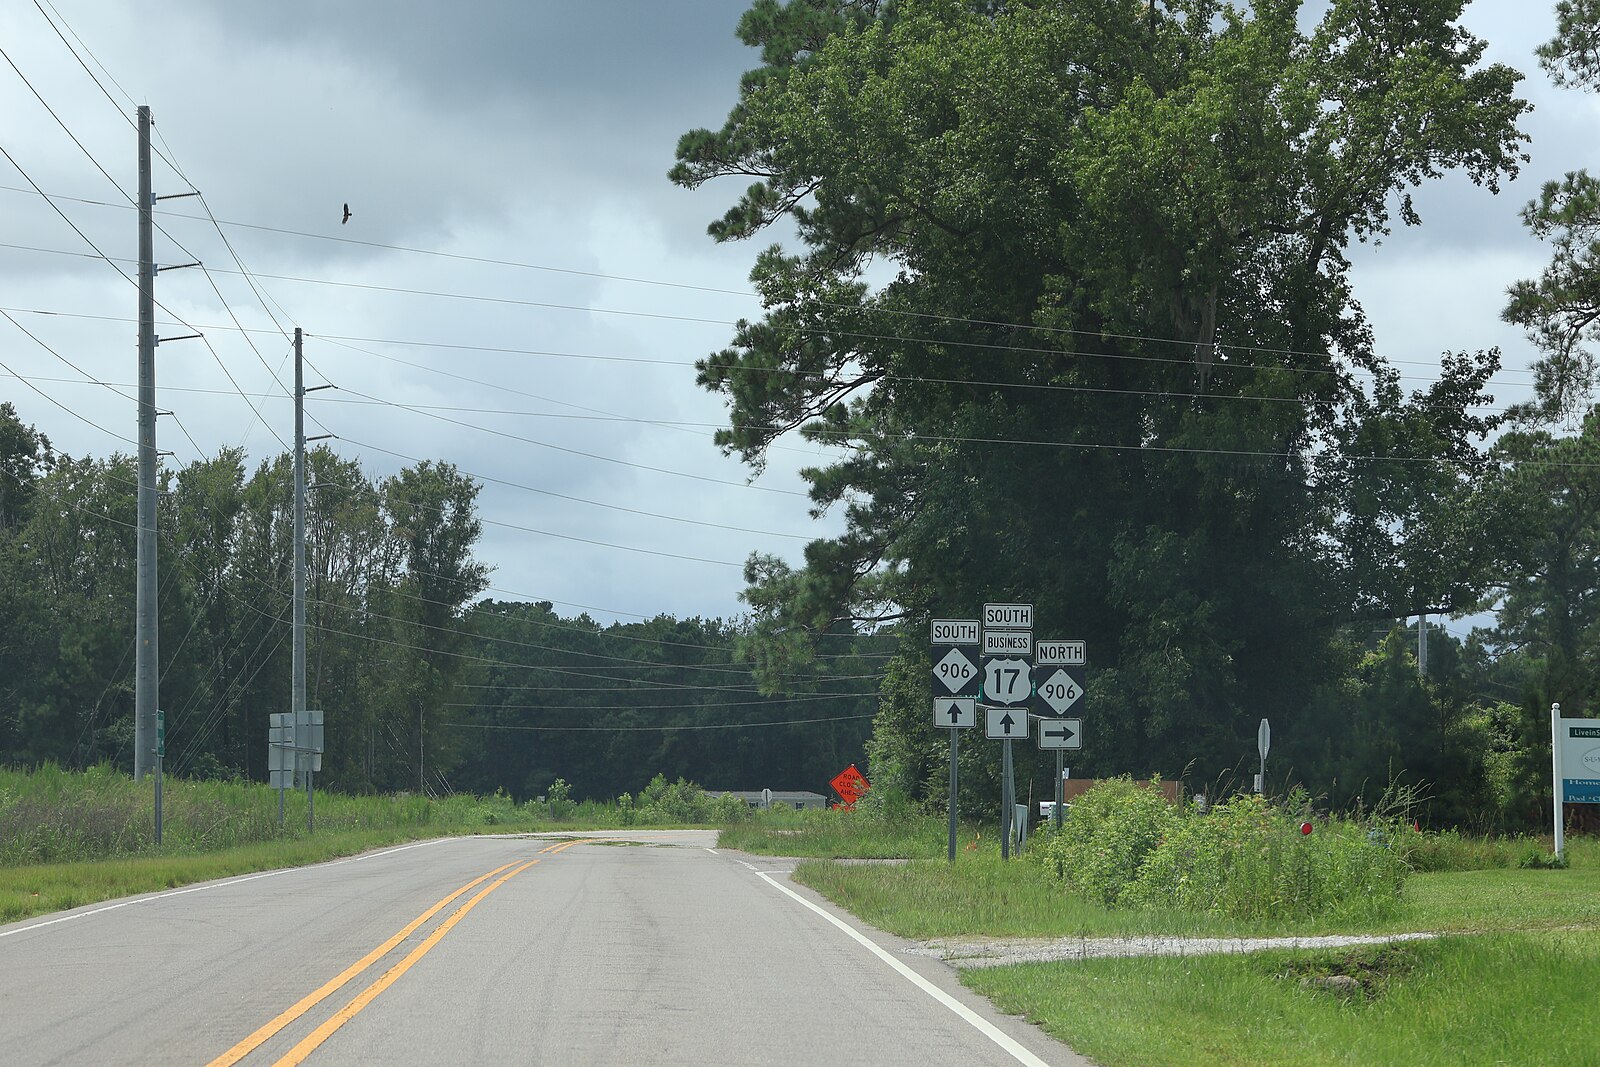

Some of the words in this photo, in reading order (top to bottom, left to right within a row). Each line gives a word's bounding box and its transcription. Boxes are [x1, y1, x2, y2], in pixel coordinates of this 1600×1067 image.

[987, 609, 1029, 623] SOUTH
[935, 625, 976, 639] SOUTH
[988, 637, 1028, 649] BUSINESS
[1039, 646, 1083, 660] NORTH
[940, 663, 970, 679] 906
[994, 668, 1021, 694] 17
[1045, 684, 1076, 700] 906
